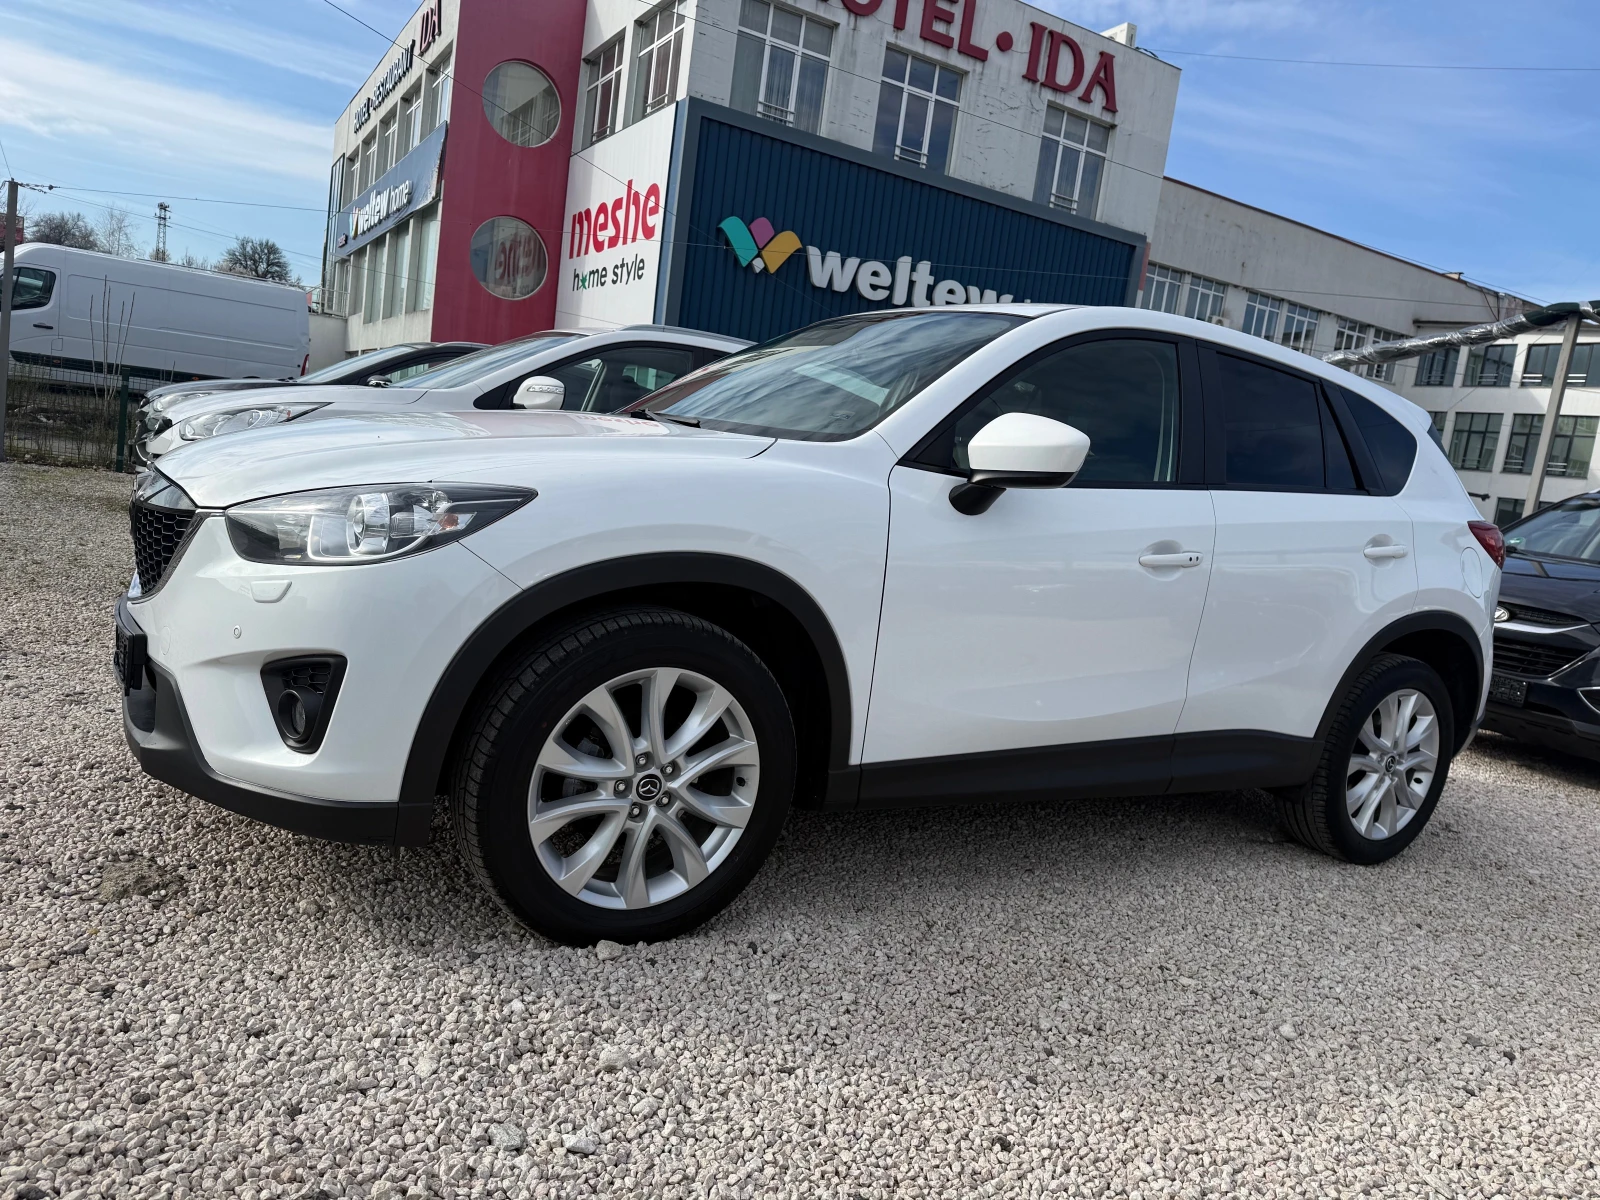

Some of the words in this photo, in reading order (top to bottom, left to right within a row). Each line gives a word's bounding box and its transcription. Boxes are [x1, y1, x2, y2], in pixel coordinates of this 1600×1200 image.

[418, 0, 442, 57] IDA
[1022, 21, 1119, 113] IDA
[358, 189, 390, 235] weltew
[389, 180, 411, 215] home
[569, 179, 660, 260] meshe
[611, 253, 645, 286] style
